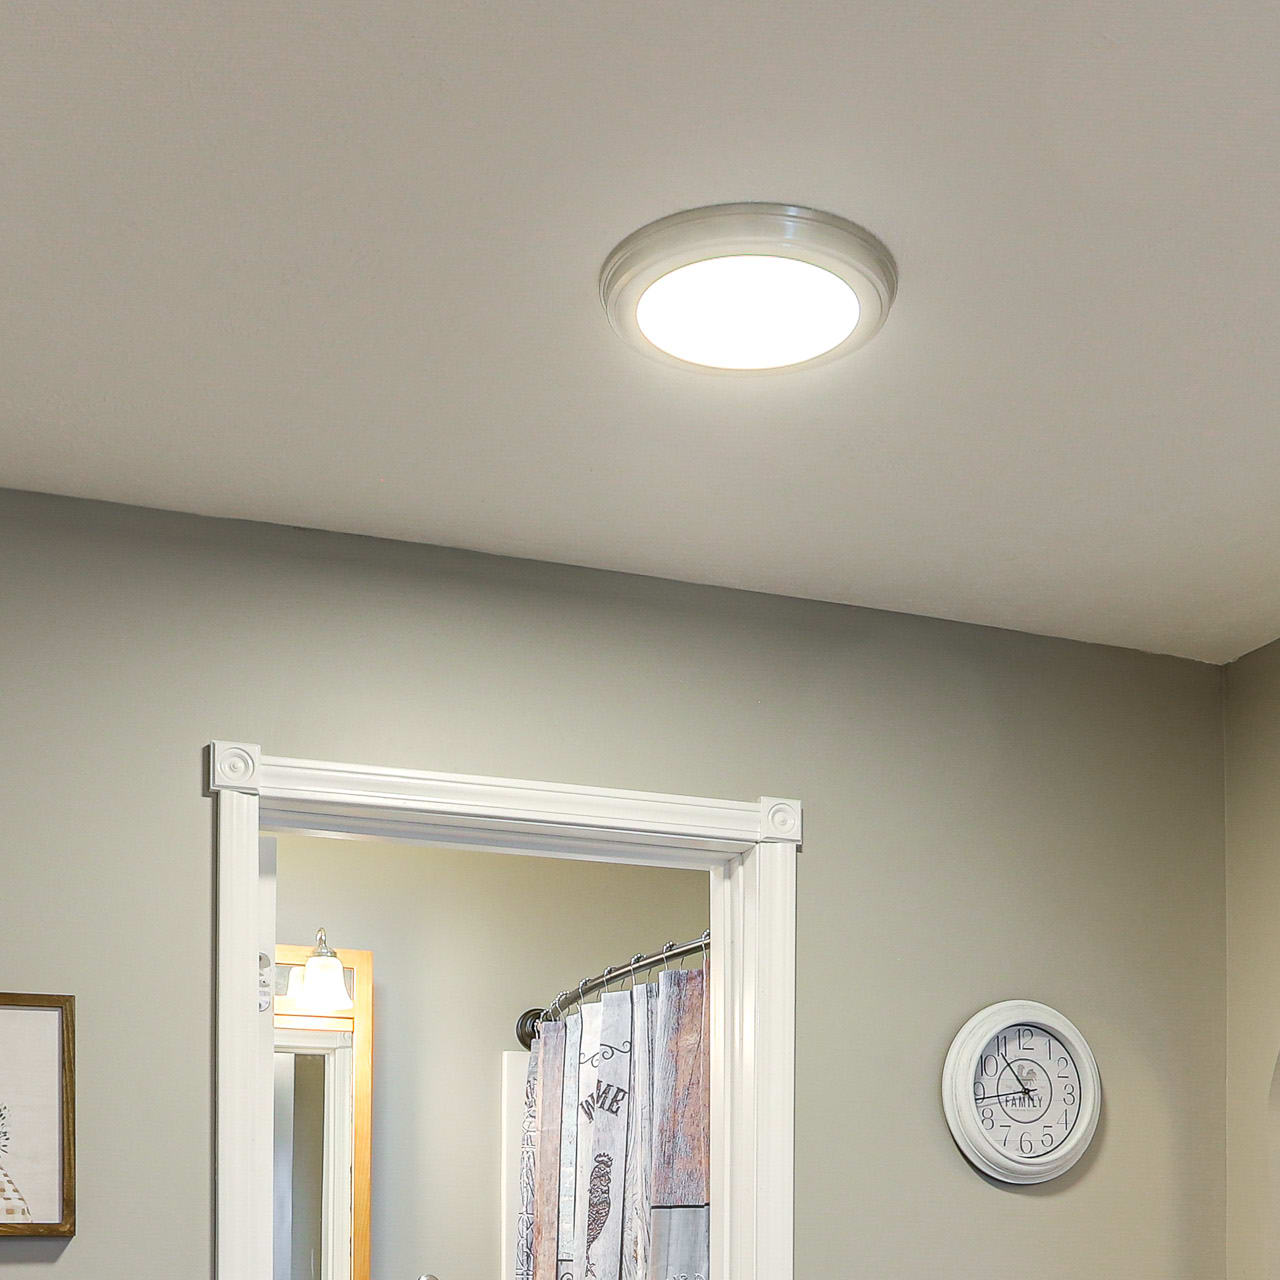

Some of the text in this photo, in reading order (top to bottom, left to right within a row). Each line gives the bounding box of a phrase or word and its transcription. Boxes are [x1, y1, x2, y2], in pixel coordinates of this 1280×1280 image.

[994, 1035, 1008, 1057] 11
[1017, 1028, 1035, 1051] 12
[1045, 1038, 1052, 1061] 1
[980, 1054, 998, 1078] 10
[1057, 1056, 1069, 1079] 2
[973, 1081, 986, 1105] 9
[1004, 1095, 1044, 1108] FAMILY
[1063, 1083, 1076, 1106] 3
[981, 1107, 995, 1131] 8
[1056, 1108, 1071, 1131] 4
[999, 1125, 1012, 1147] 7
[1019, 1131, 1033, 1154] 6
[1041, 1125, 1054, 1148] 5
